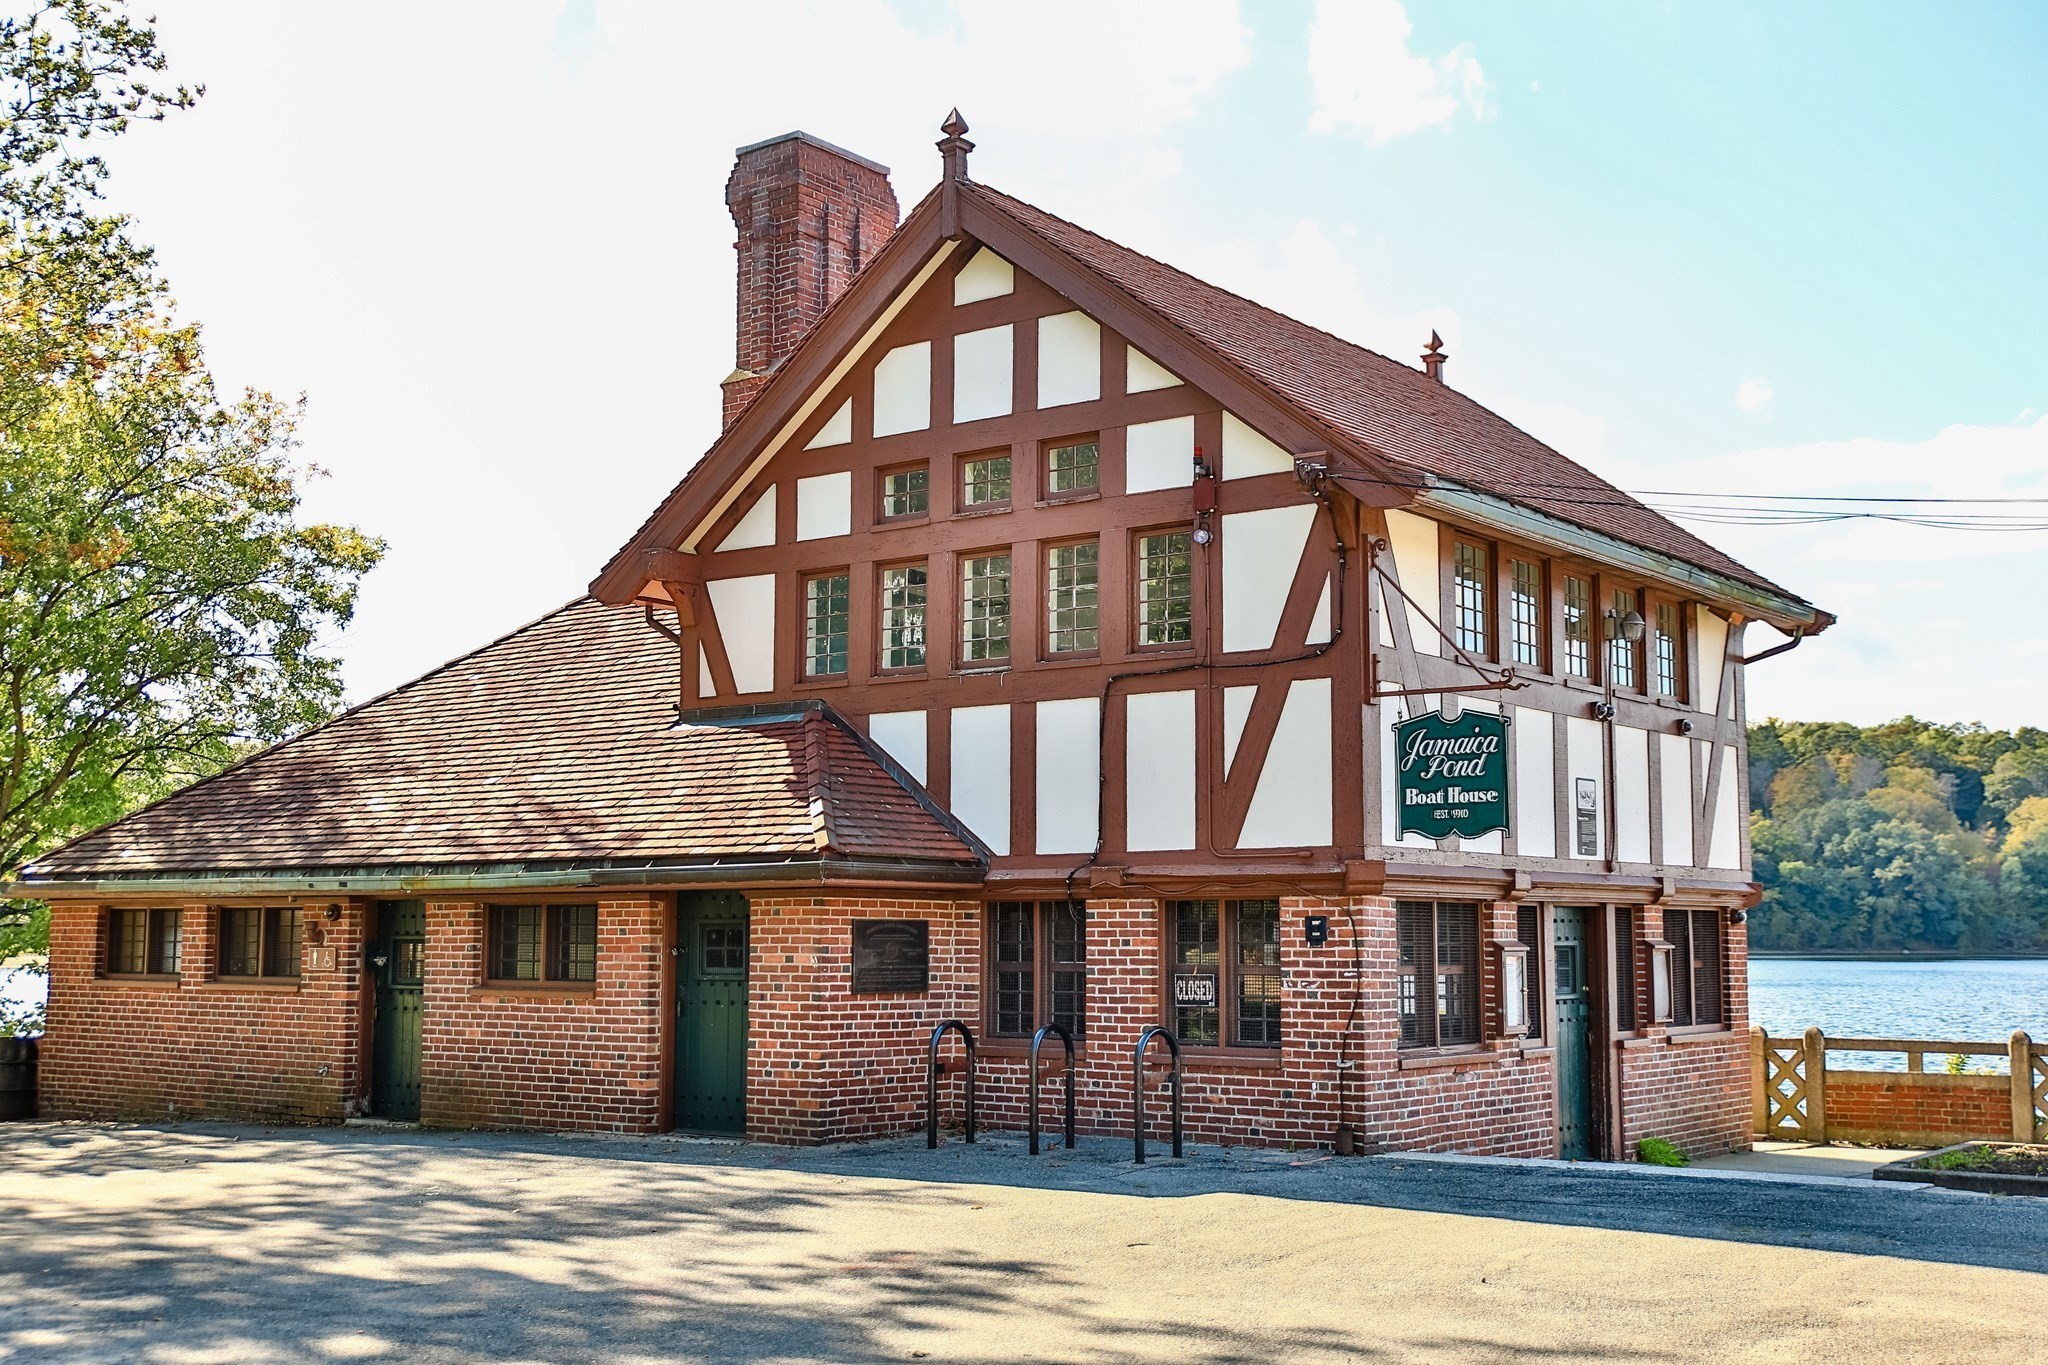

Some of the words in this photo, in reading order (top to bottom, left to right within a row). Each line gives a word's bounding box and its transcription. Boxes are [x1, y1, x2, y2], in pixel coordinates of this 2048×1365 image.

[1401, 727, 1499, 771] Jamaica
[1420, 753, 1488, 779] Pond
[1405, 788, 1445, 805] Boat
[1447, 786, 1499, 803] House
[1434, 809, 1449, 819] EST.
[1177, 980, 1212, 1000] CLOSED
